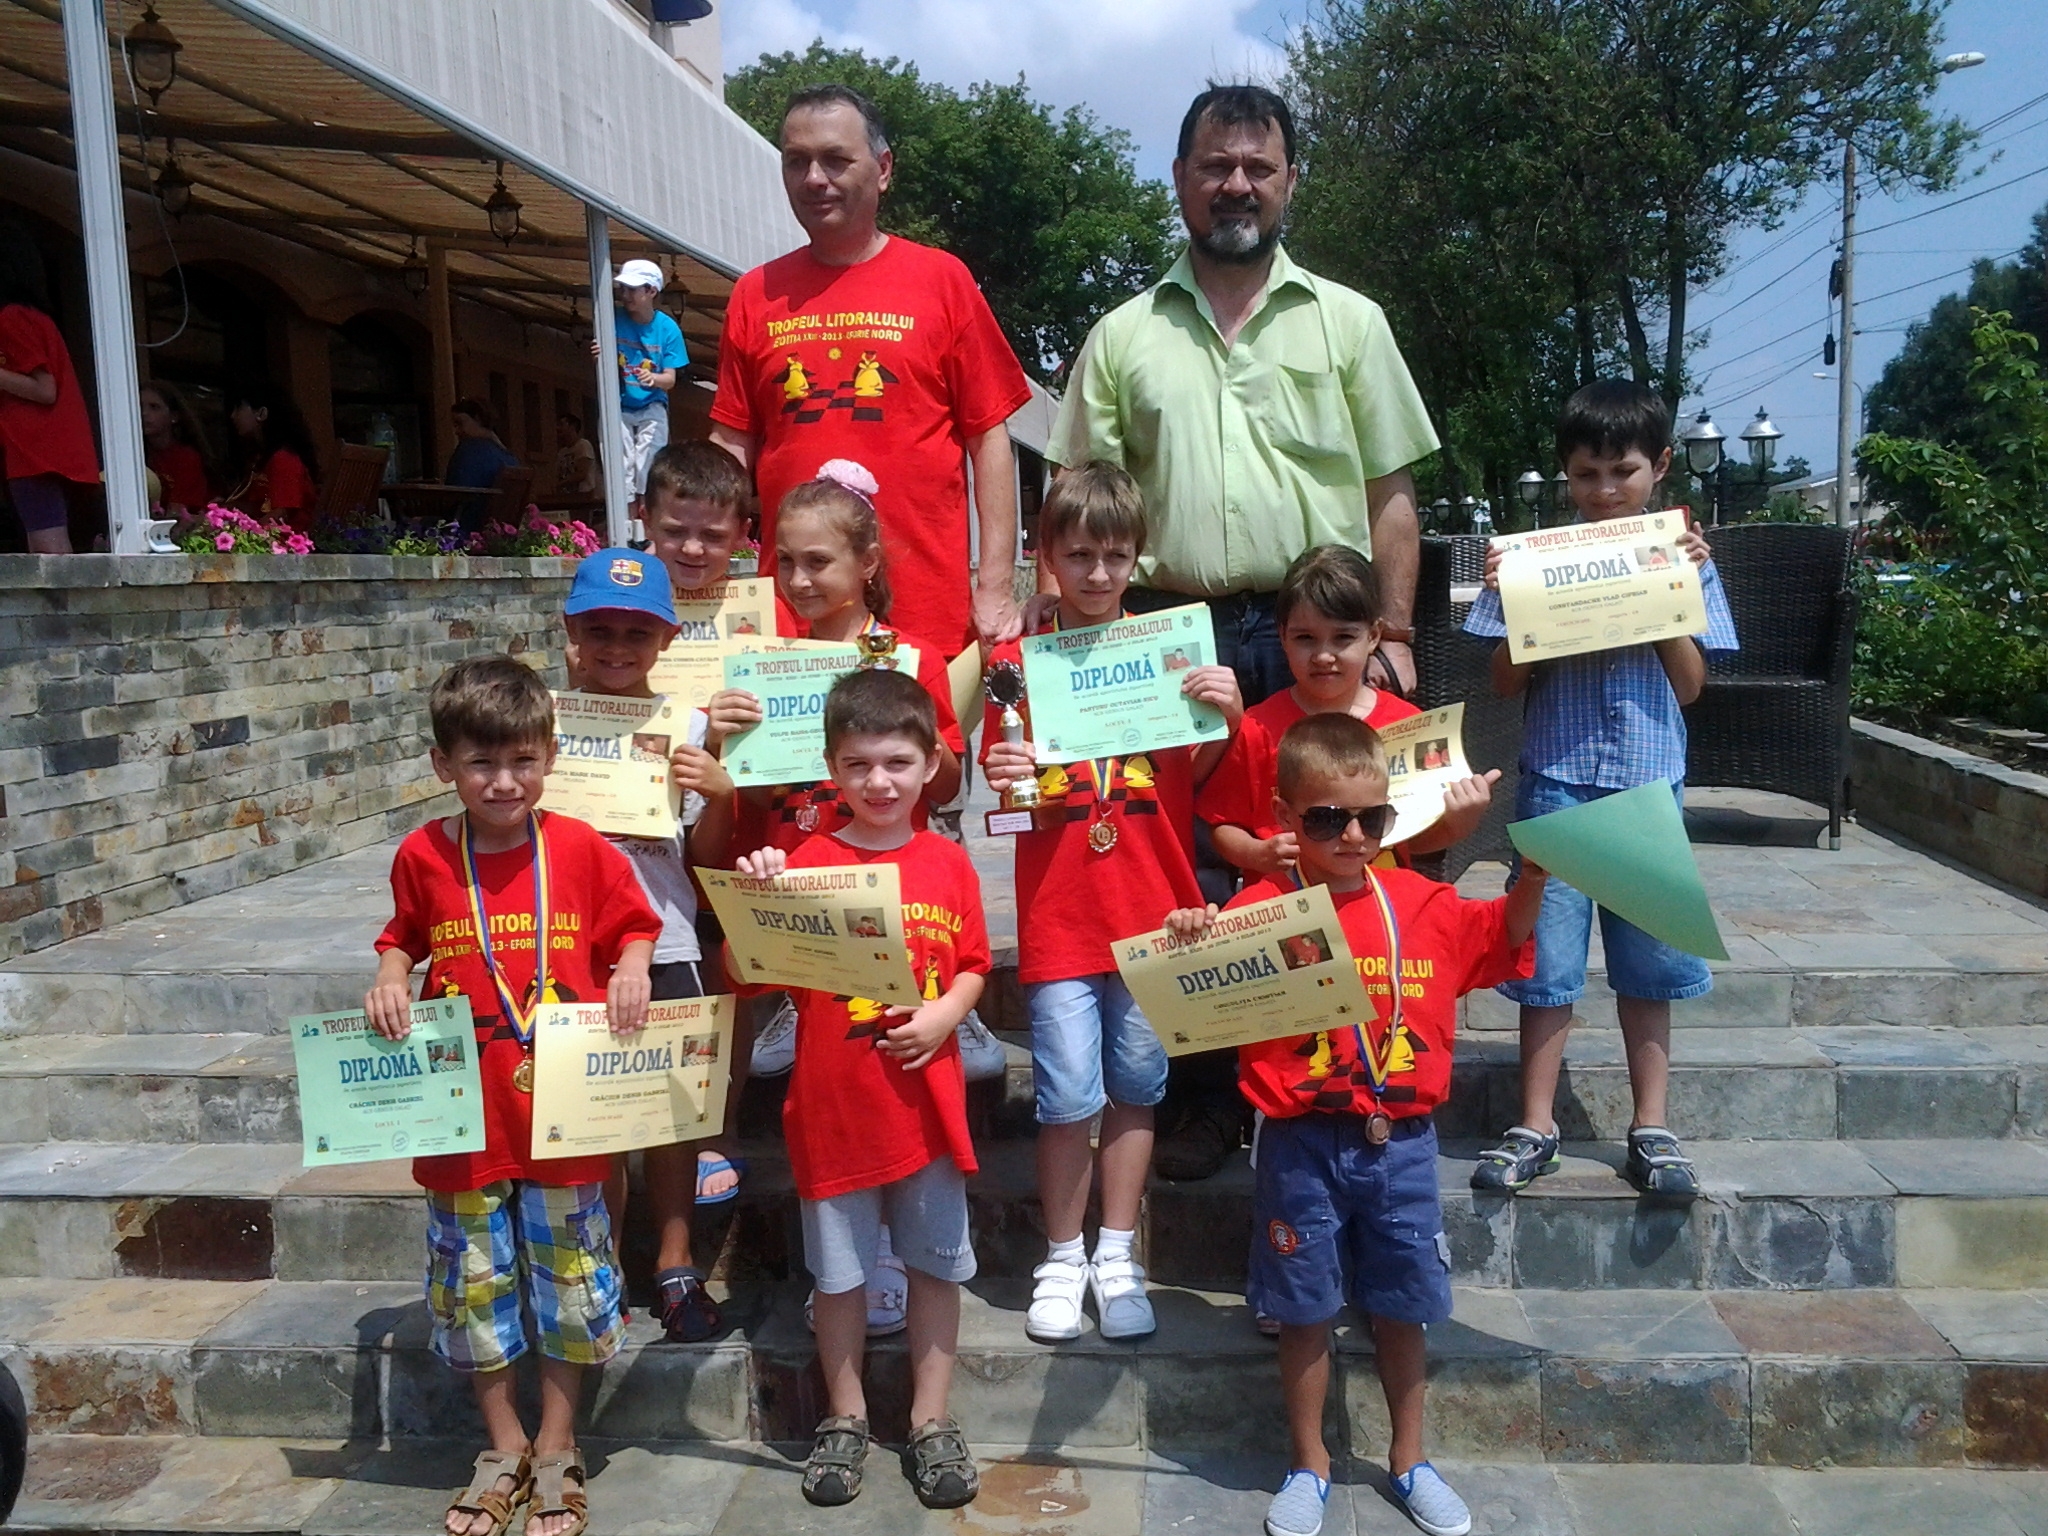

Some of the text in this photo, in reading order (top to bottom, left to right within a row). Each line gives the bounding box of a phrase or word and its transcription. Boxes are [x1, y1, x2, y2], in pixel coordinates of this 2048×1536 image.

[767, 311, 914, 337] TROFEUL LITORALULUI
[821, 332, 842, 341] 2013
[870, 329, 902, 342] NORD
[1525, 532, 1574, 549] TROFEUL
[1575, 521, 1645, 541] LITORALULUI
[1541, 552, 1632, 588] DIPLOMĂ
[1055, 630, 1104, 650] TROFEUL
[1105, 618, 1173, 641] LITORALULUI
[755, 659, 802, 675] TROFEUL
[1070, 652, 1156, 692] DIPLOMĂ
[583, 699, 653, 718] LITORALULUI
[781, 873, 857, 892] LITORALULUI
[750, 908, 838, 936] DIPLOMĂ
[1209, 904, 1287, 939] LITORALULUI
[1176, 947, 1279, 995] DIPLOMĂ
[338, 1045, 423, 1083] DIPLOMĂ
[585, 1040, 674, 1076] DIPLOMĂ
